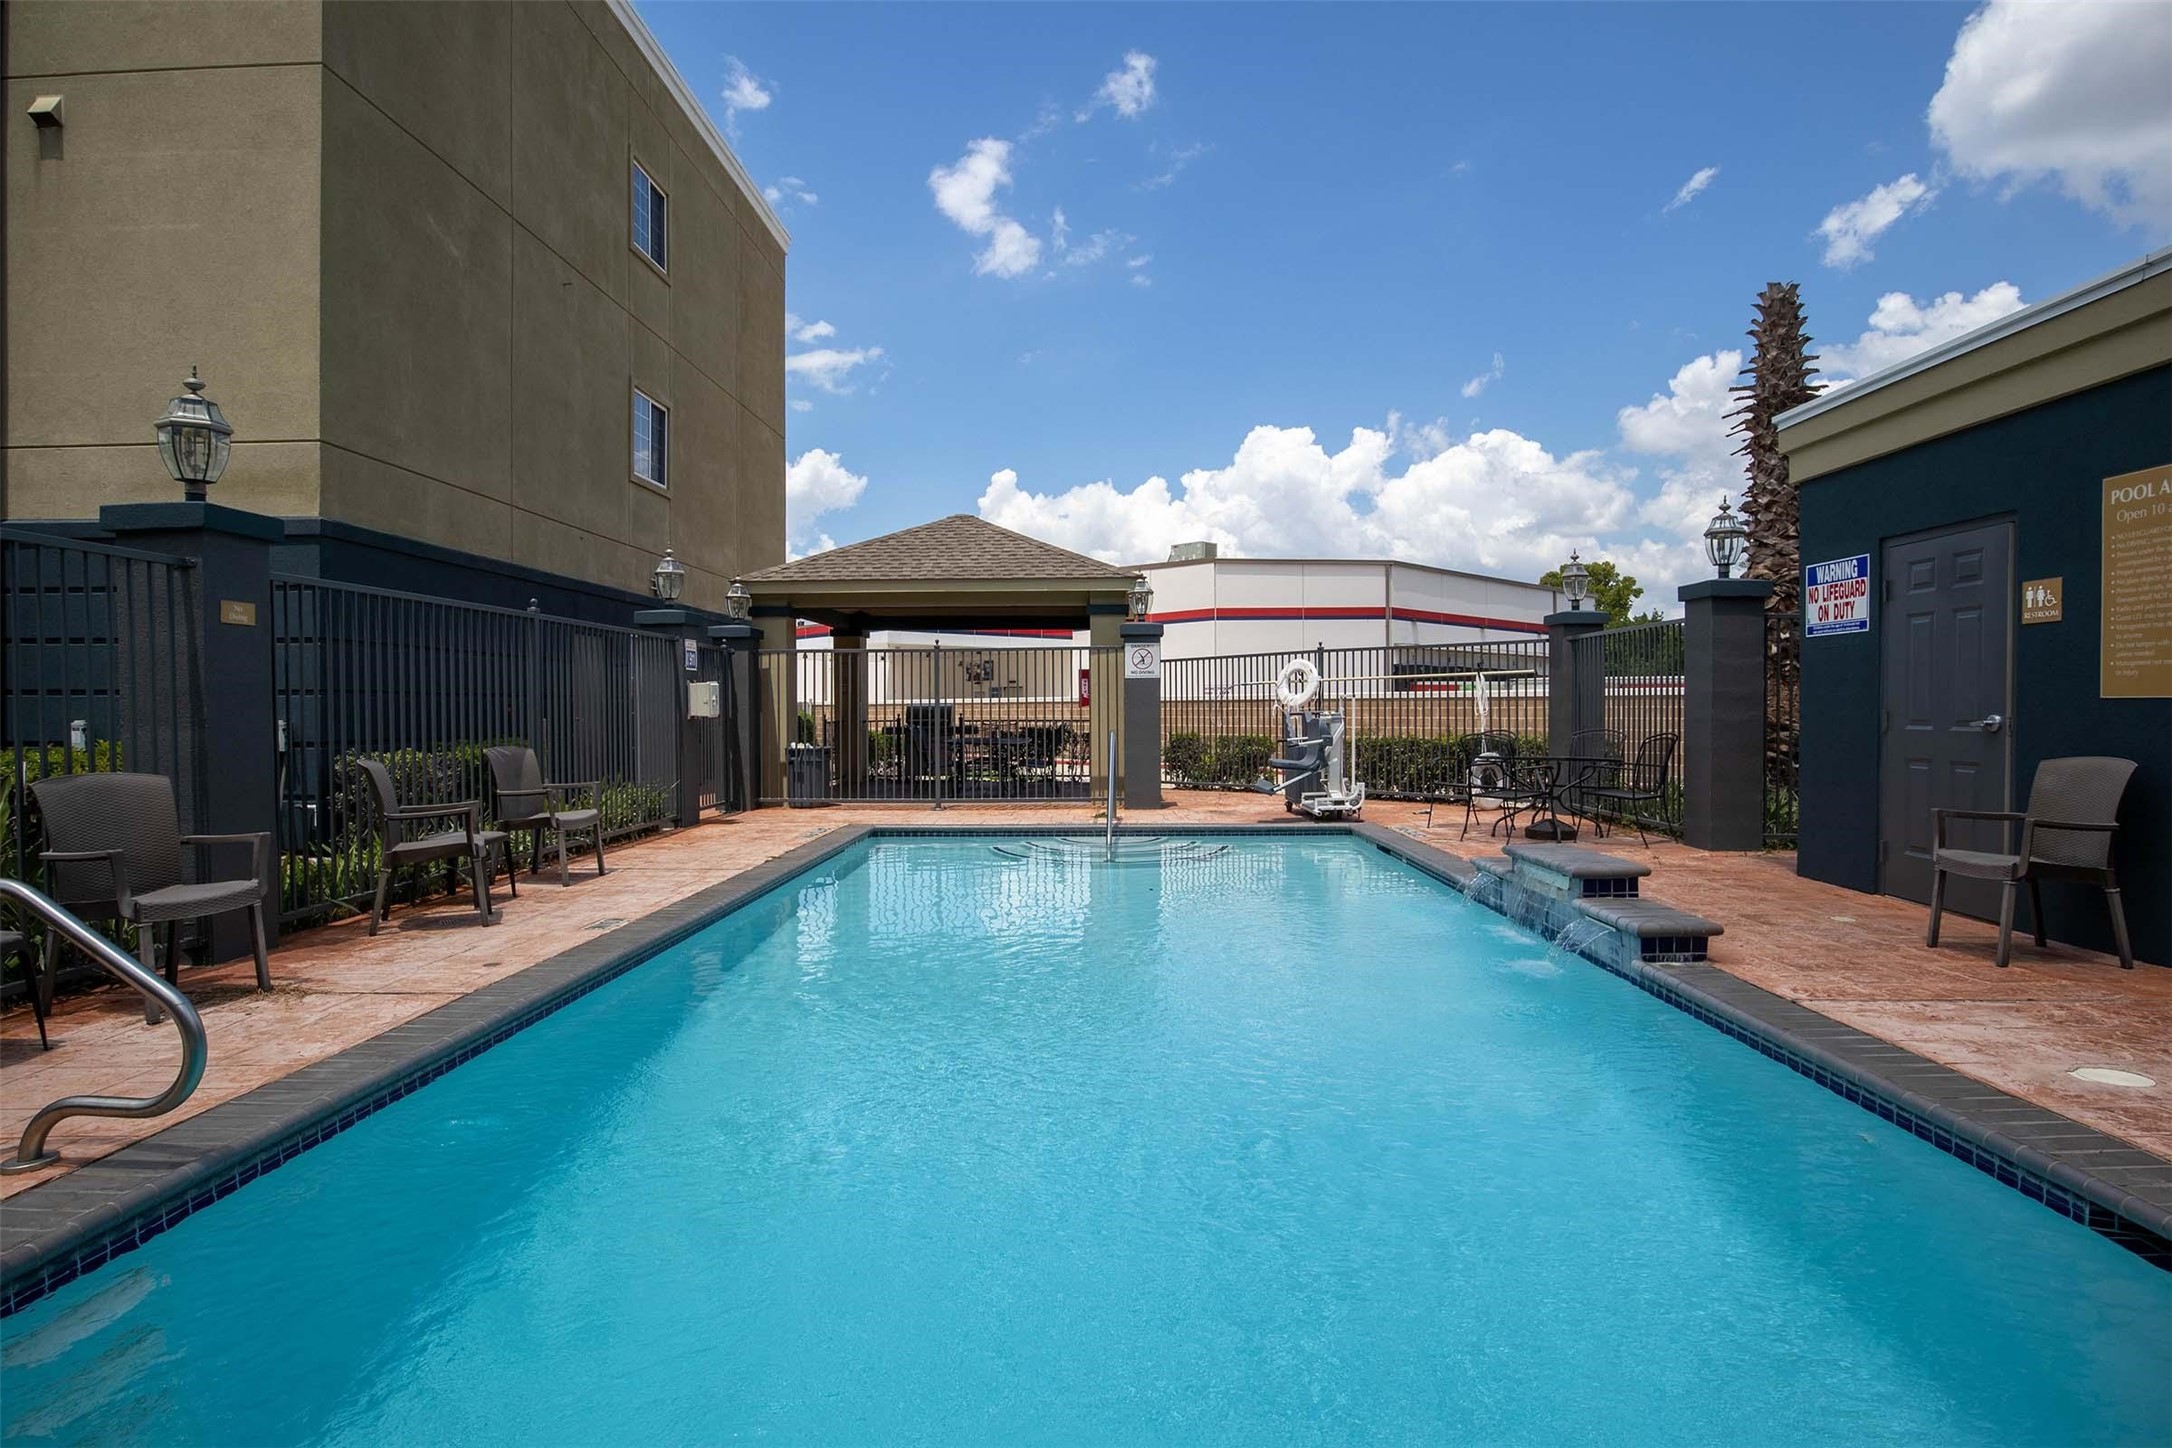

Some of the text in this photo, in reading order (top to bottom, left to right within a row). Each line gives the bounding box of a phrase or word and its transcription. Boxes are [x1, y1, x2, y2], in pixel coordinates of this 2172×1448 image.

[2111, 479, 2172, 505] POOL A
[2116, 509, 2147, 524] Open
[2151, 503, 2165, 515] 10
[1816, 560, 1858, 584] WARNING
[1808, 579, 1866, 605] NO LIFEGUARD
[1818, 601, 1856, 622] ON DUTY
[2024, 610, 2059, 619] RESTROOM
